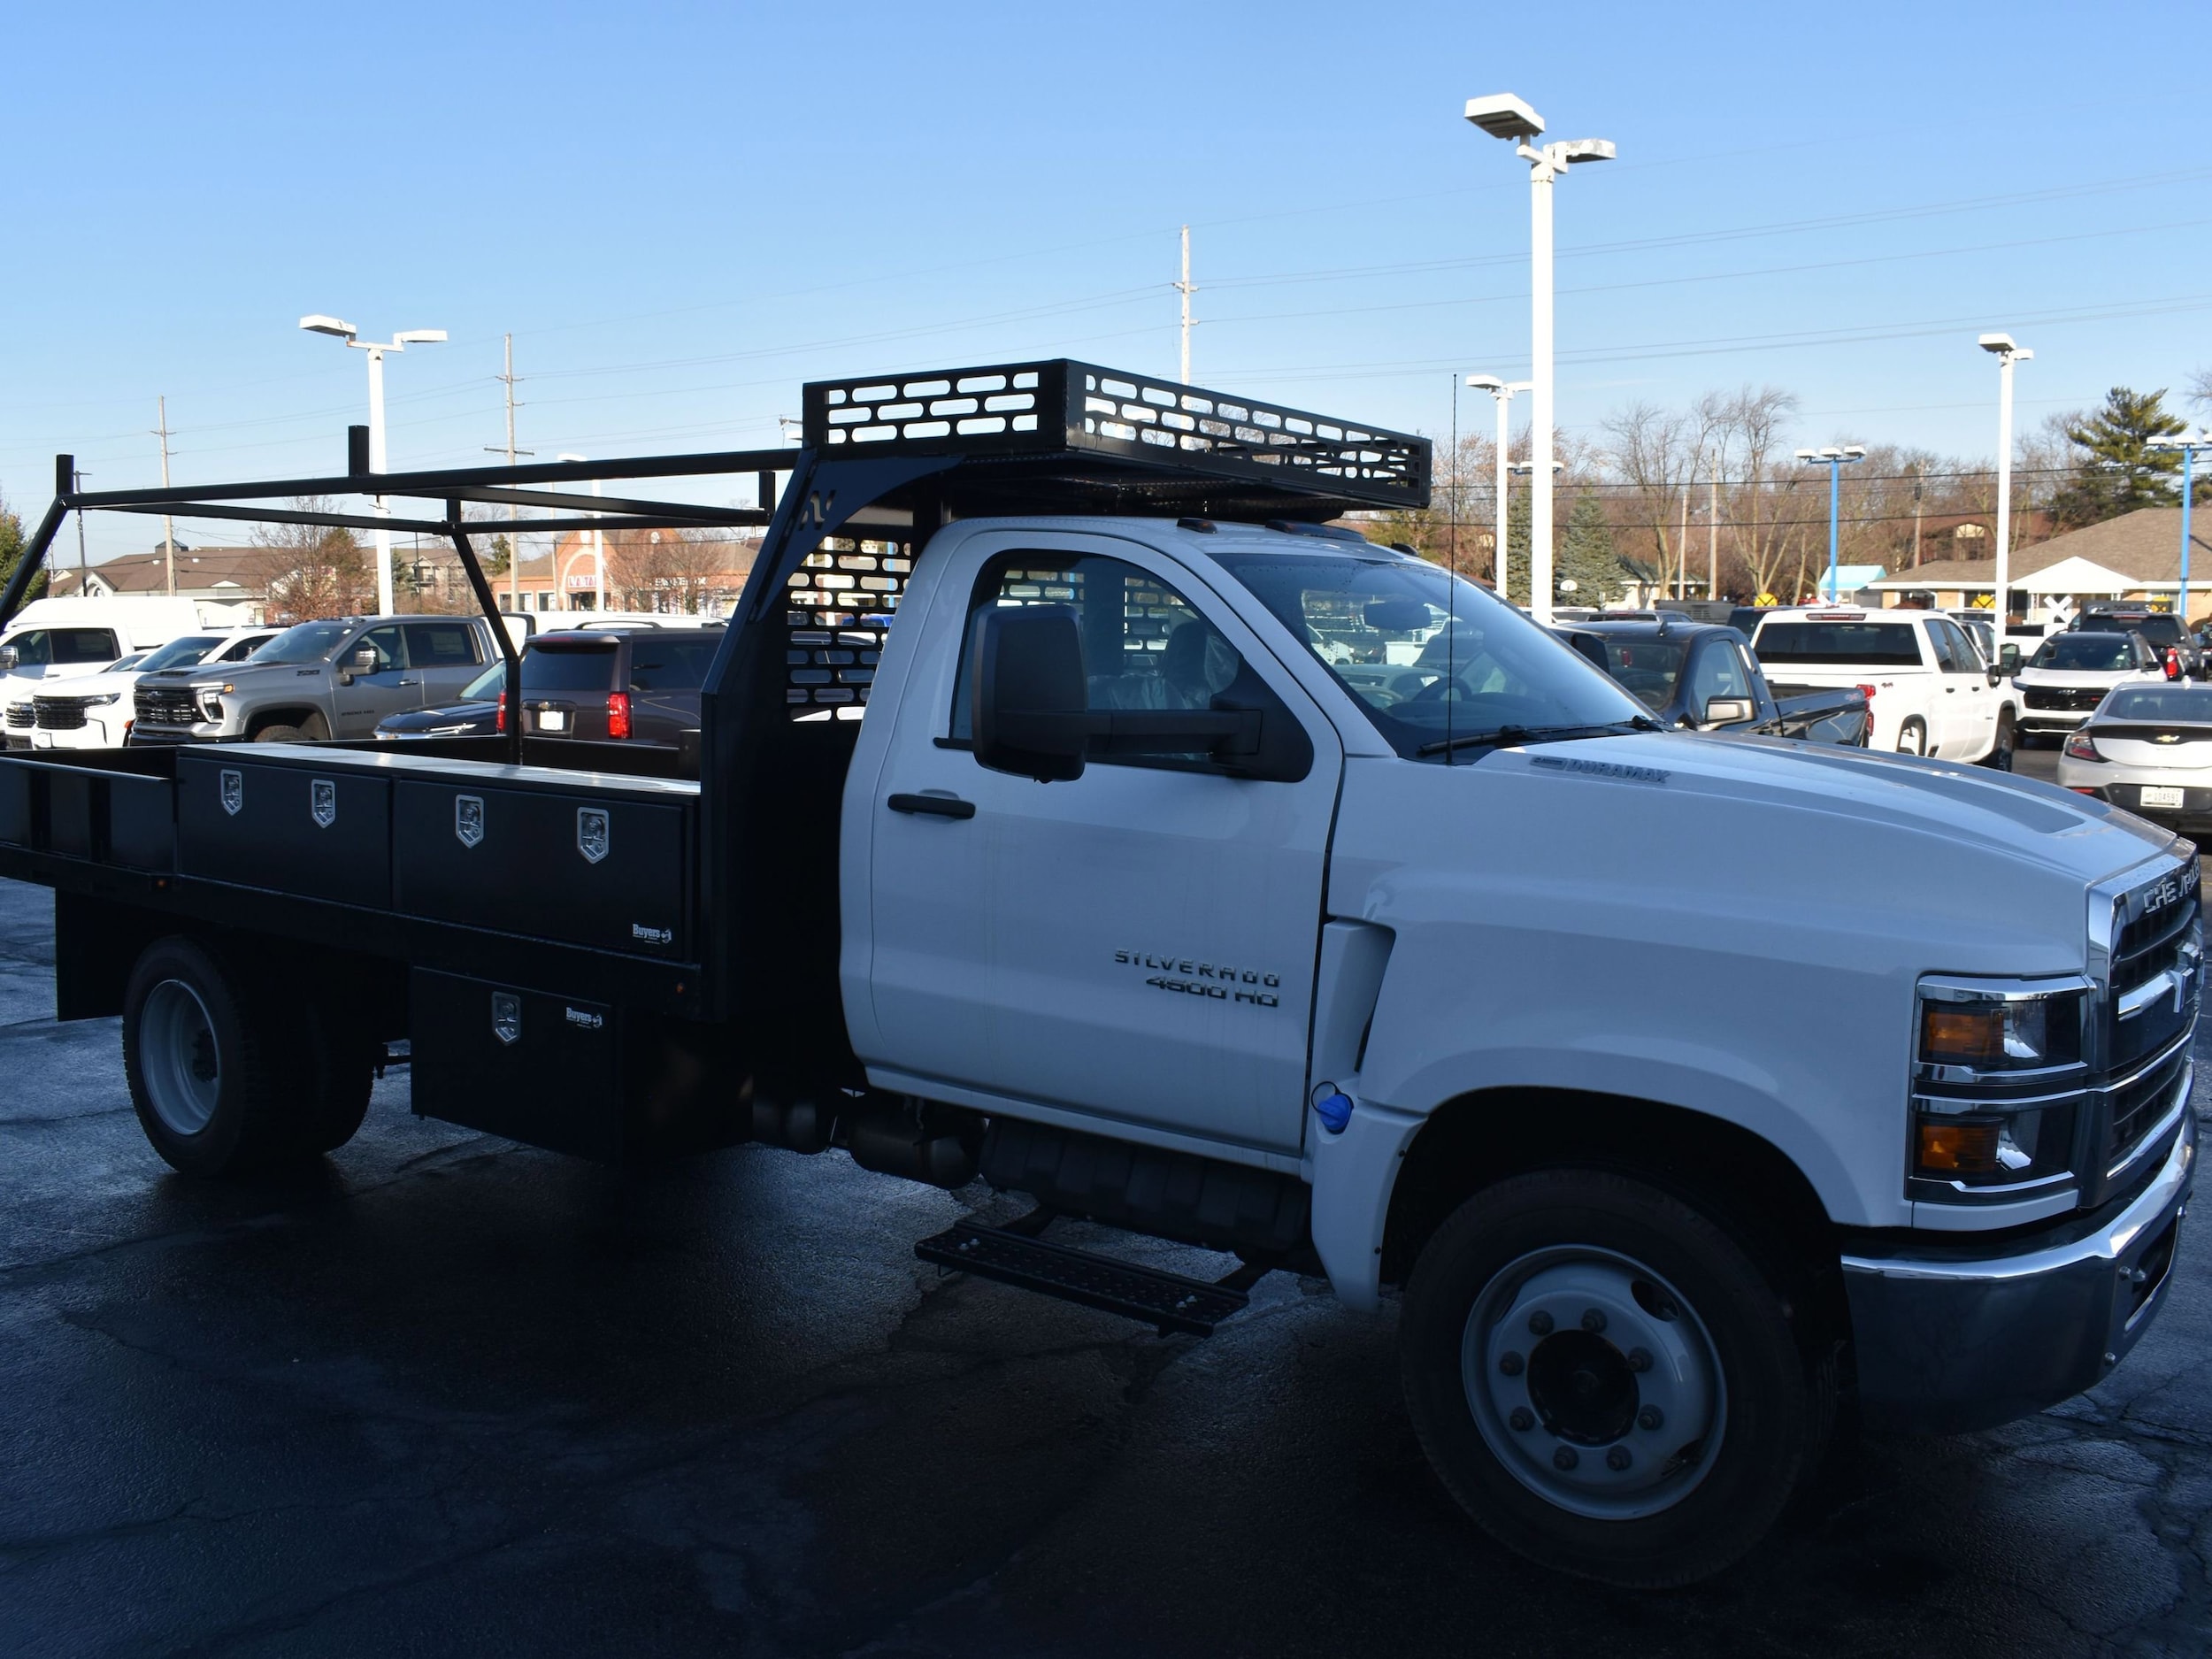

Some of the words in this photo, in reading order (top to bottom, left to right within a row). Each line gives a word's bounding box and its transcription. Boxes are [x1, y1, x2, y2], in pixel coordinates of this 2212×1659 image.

[584, 576, 597, 586] TA
[1565, 758, 1671, 784] DURAMAX
[633, 923, 660, 939] Buyers
[1115, 948, 1280, 987] SILVERADO
[1146, 975, 1227, 1000] 4500
[1234, 987, 1279, 1008] HD
[566, 1006, 592, 1022] Buyers
